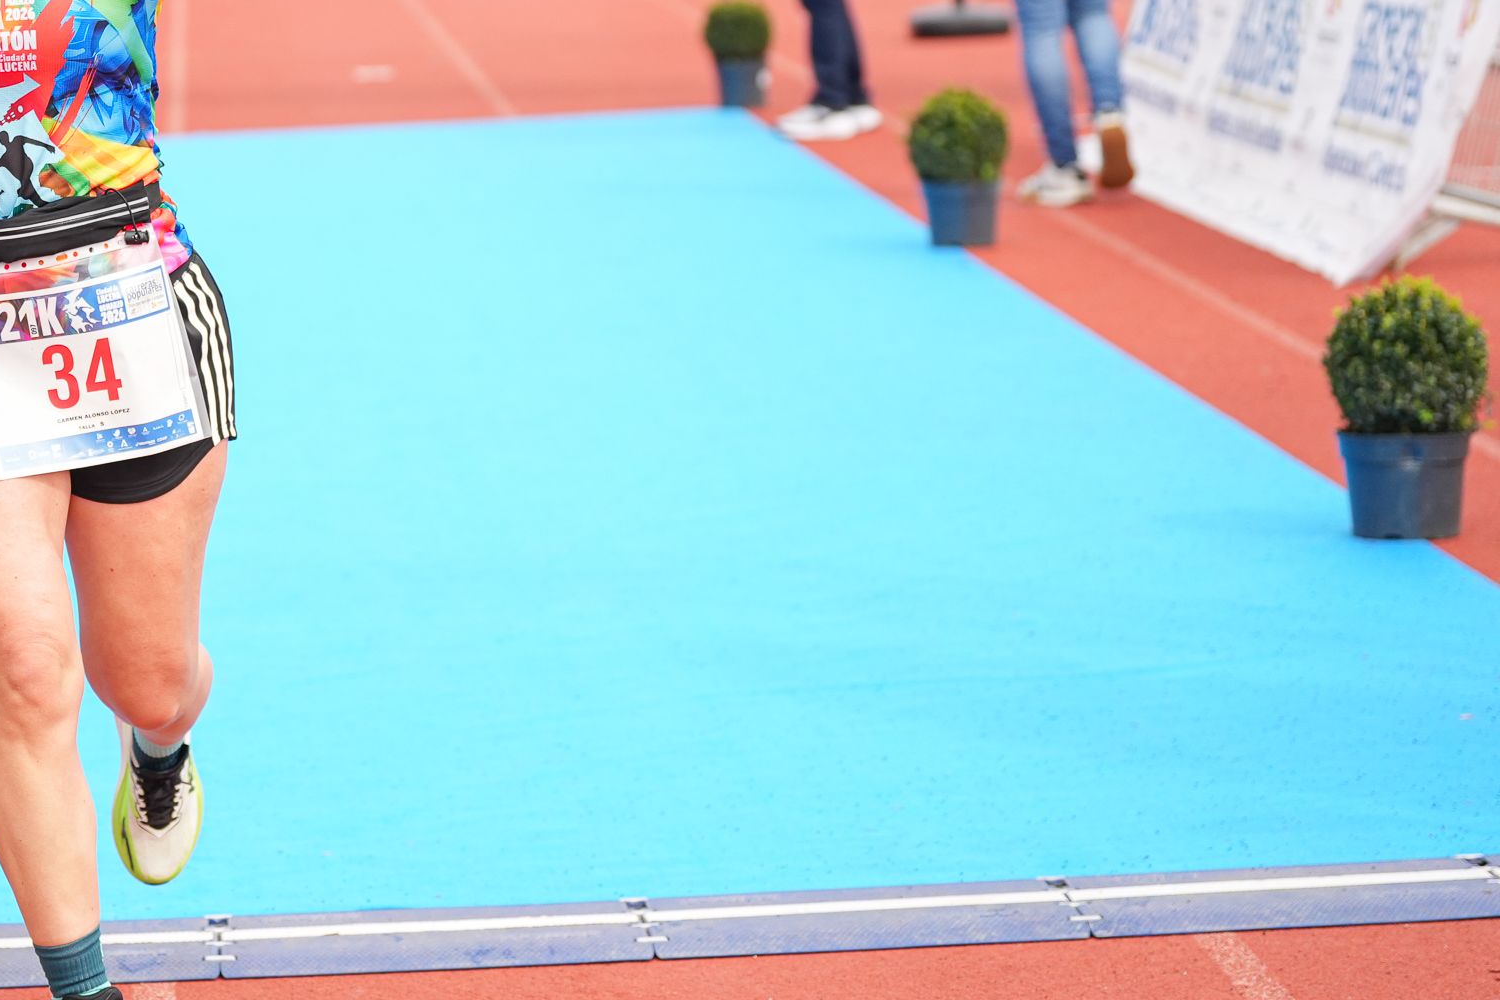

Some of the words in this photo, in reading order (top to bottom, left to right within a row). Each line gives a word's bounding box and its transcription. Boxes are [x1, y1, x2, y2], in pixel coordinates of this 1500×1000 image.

[5, 6, 36, 21] 2026
[27, 53, 37, 61] de
[101, 307, 127, 325] 2026
[42, 337, 122, 409] 34
[57, 416, 83, 424] CARMEN
[84, 411, 109, 419] ALONSO
